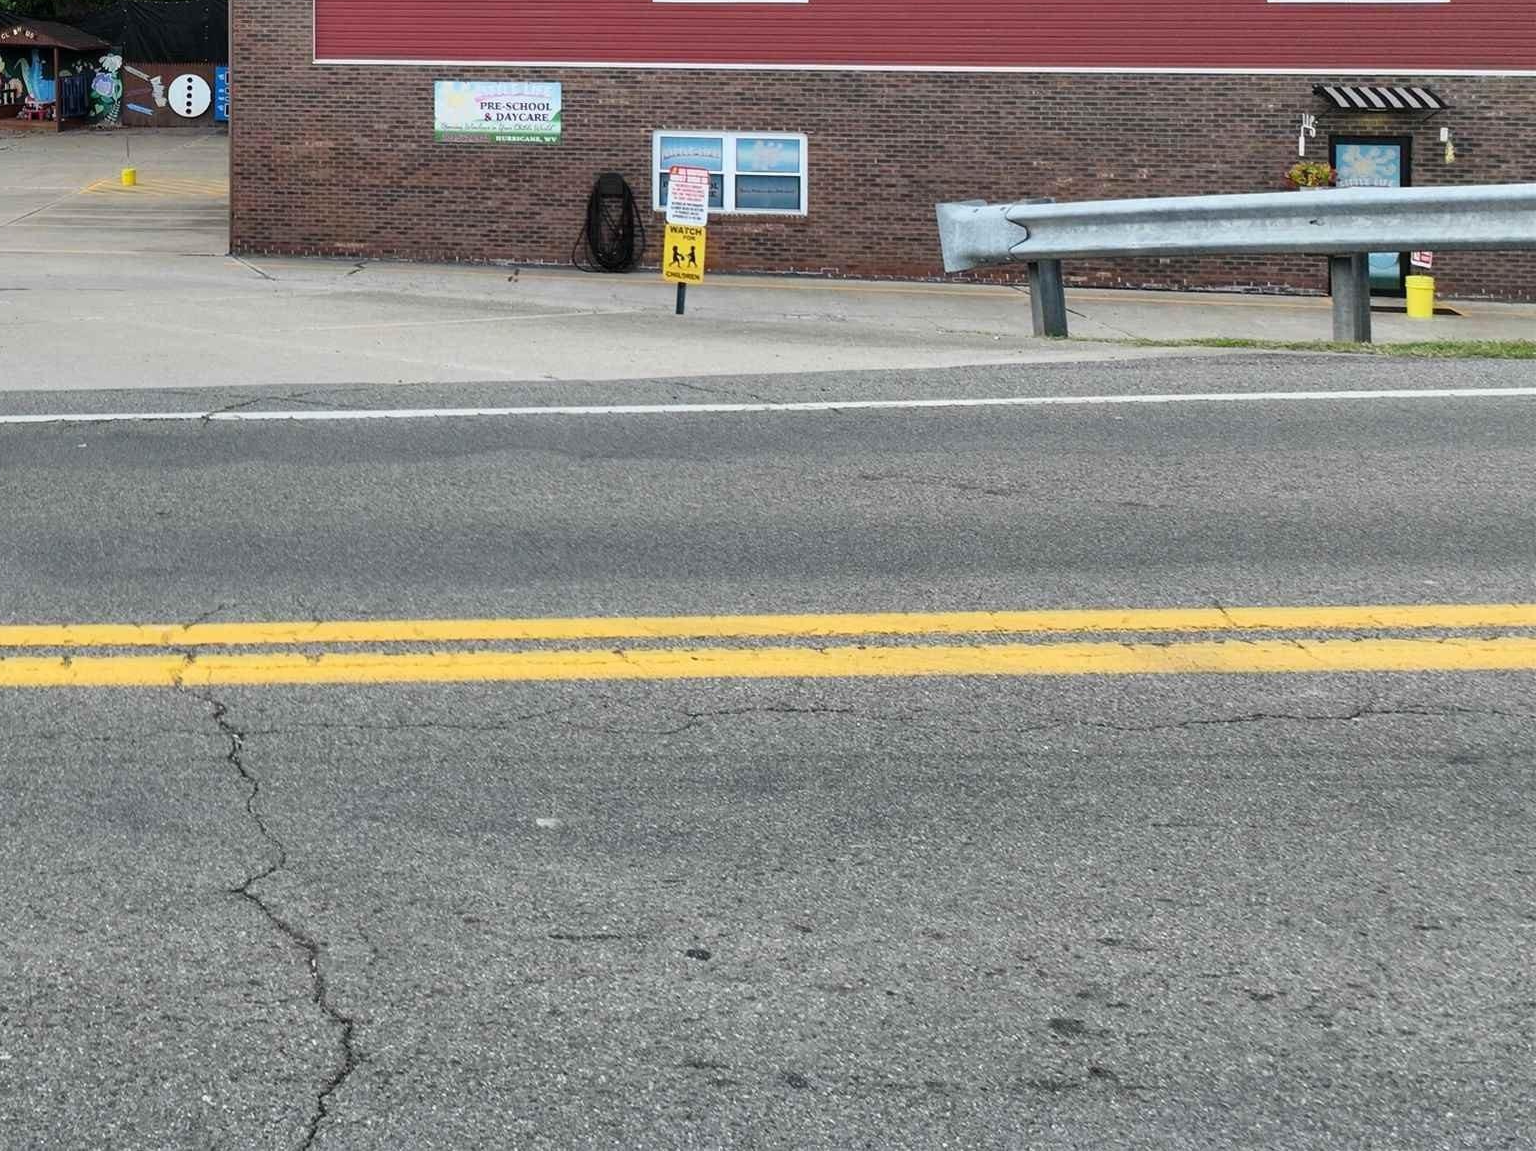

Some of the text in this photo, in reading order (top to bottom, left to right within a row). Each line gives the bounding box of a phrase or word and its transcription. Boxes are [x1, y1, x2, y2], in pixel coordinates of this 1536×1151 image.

[480, 102, 552, 111] PRE-SCHOOL
[484, 113, 549, 122] & DAYCARE
[670, 226, 702, 236] WATCH
